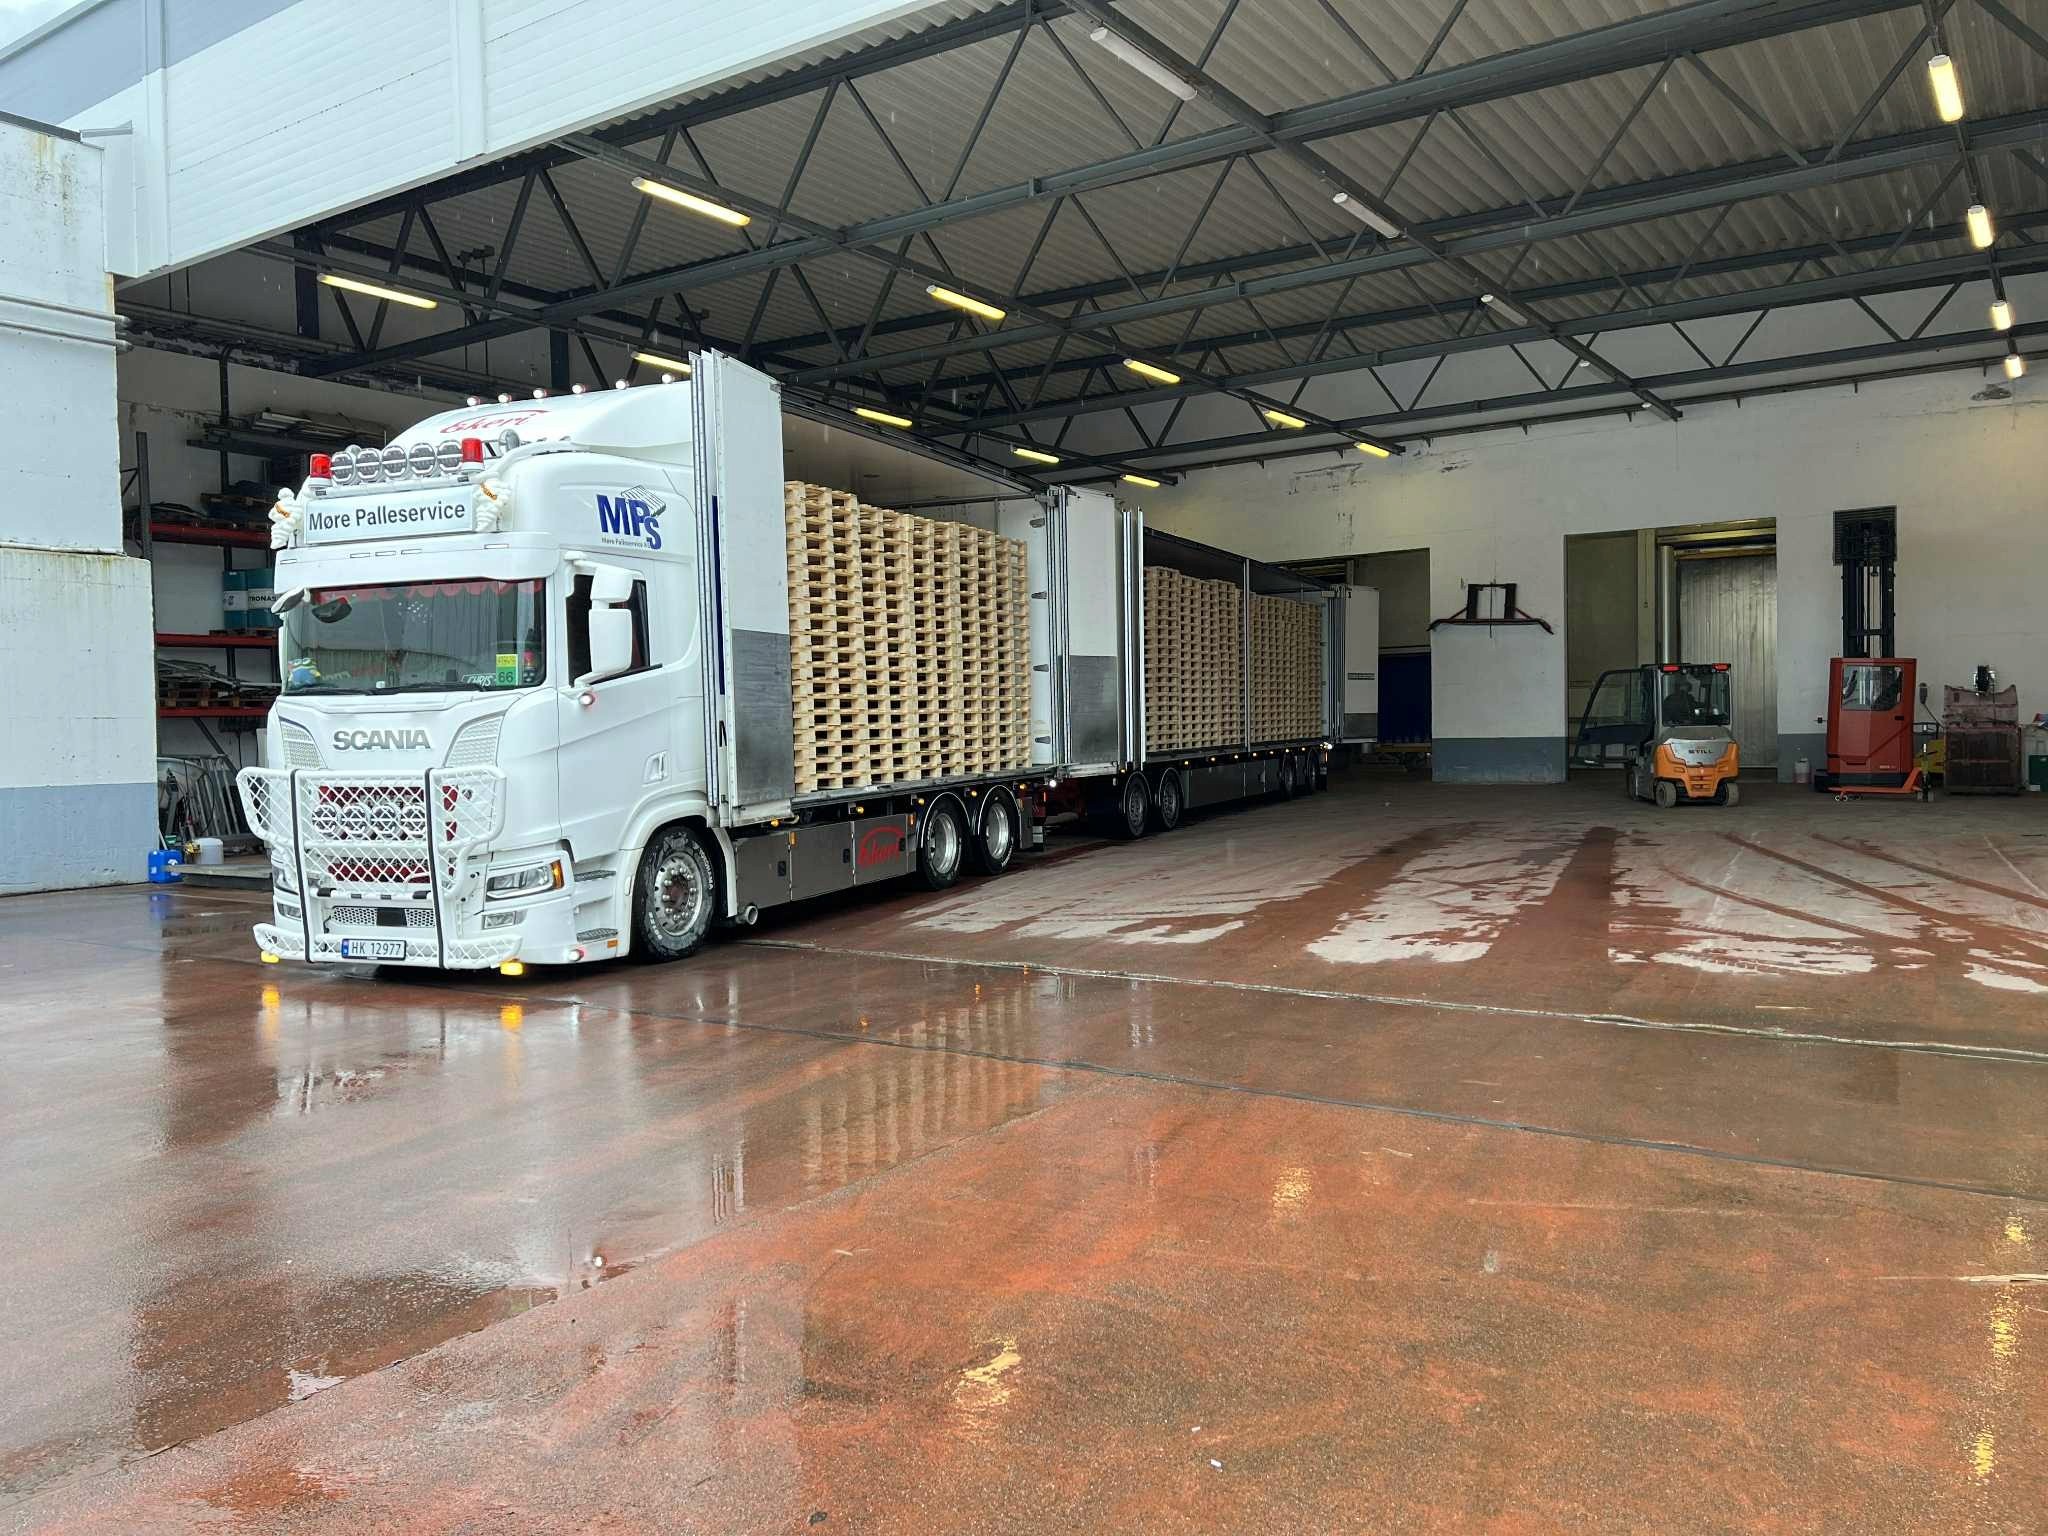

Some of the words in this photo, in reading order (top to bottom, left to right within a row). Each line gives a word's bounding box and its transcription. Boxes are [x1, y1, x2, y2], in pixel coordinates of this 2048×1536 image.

[309, 512, 350, 530] Møre
[356, 500, 465, 526] Palleservice
[597, 494, 662, 550] MPS
[498, 671, 514, 683] 66
[333, 730, 431, 750] SCANIA
[352, 941, 366, 955] HK
[371, 942, 401, 956] 12977
